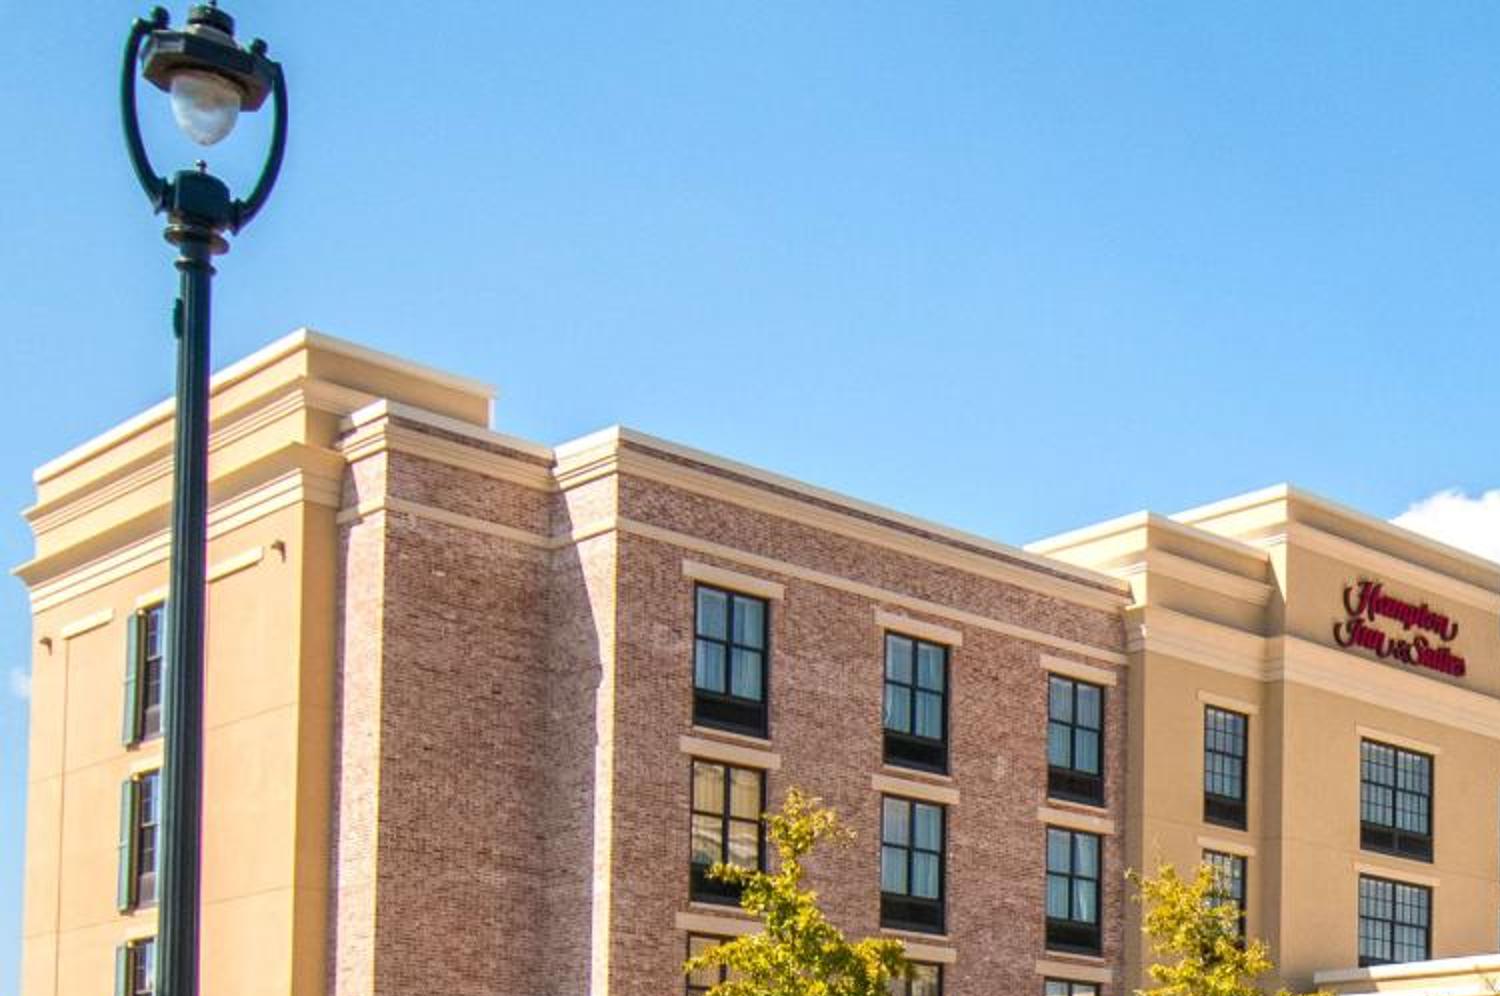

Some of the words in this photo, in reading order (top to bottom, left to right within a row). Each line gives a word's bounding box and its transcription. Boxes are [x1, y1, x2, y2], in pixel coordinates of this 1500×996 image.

[1343, 581, 1459, 641] Hampton
[1333, 618, 1394, 658] Inn
[1390, 638, 1411, 663] &
[1409, 635, 1467, 677] Suites
